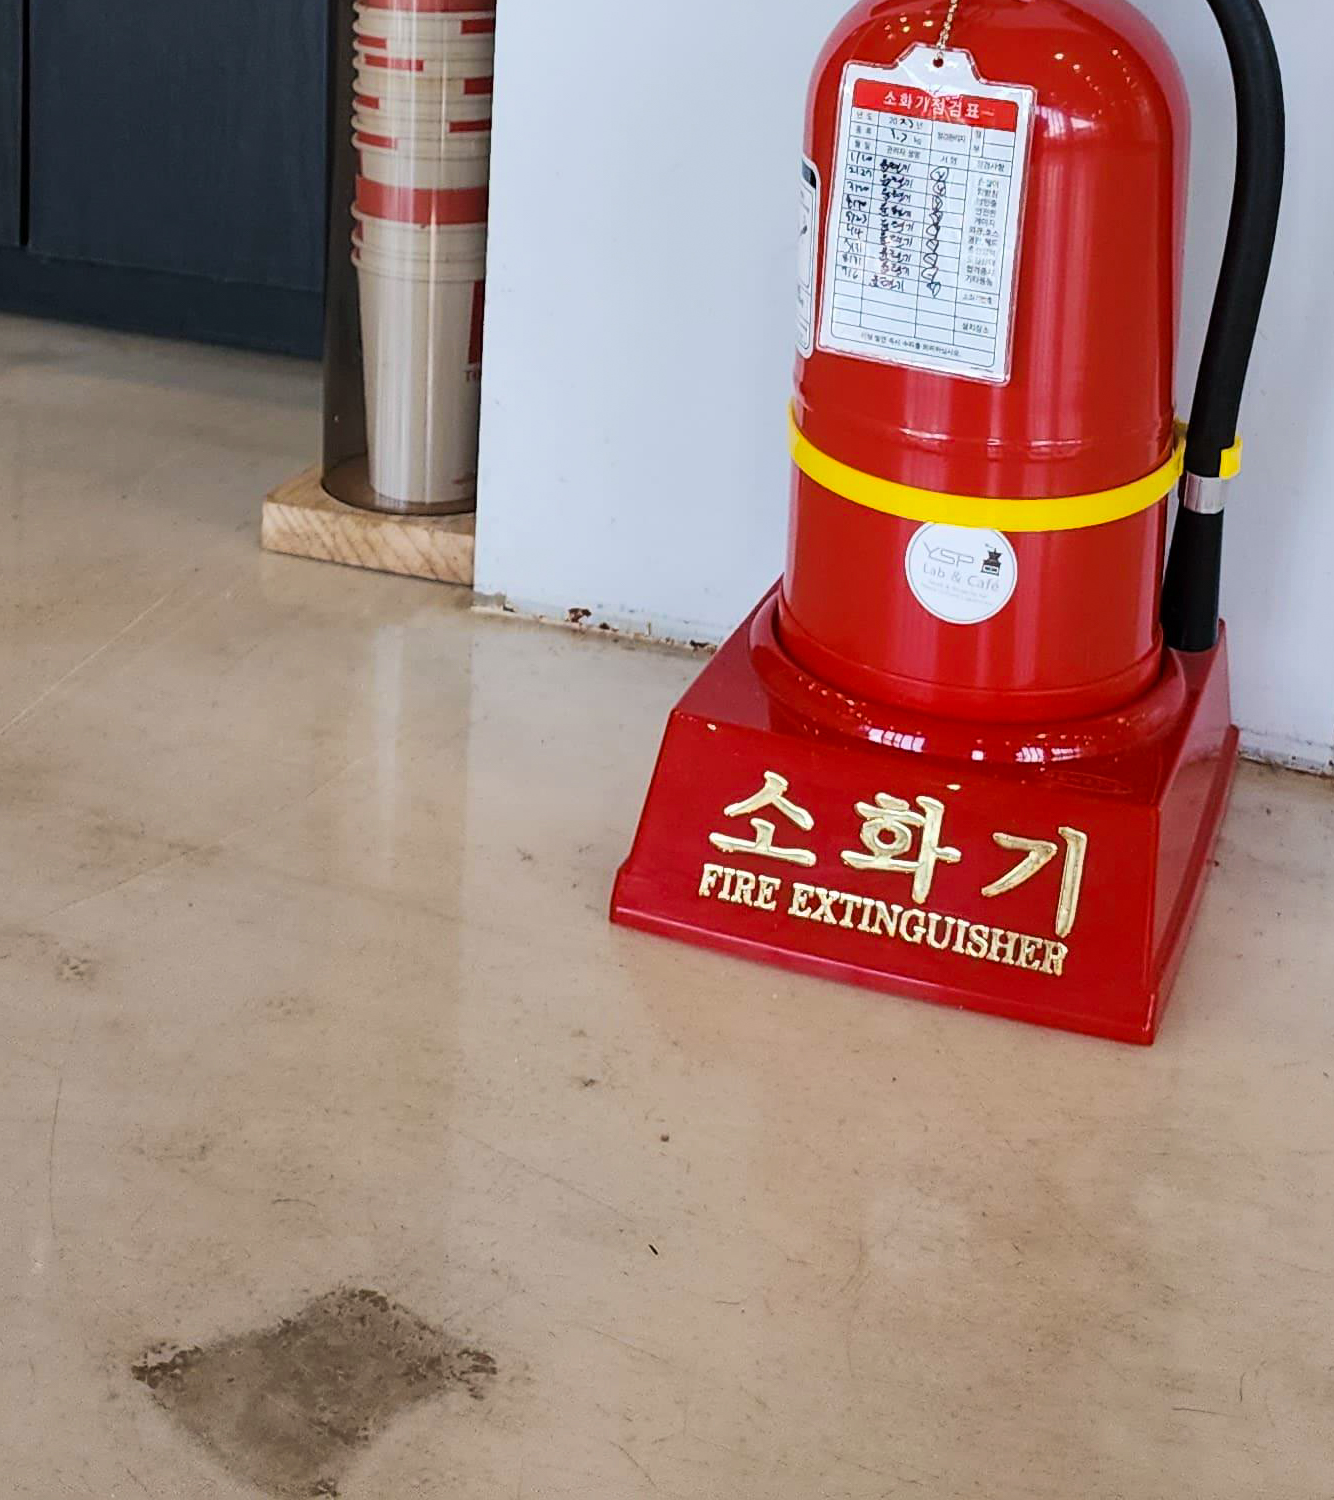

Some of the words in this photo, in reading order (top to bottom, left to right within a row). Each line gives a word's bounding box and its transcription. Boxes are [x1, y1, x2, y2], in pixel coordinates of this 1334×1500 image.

[699, 863, 782, 911] FIRE
[787, 883, 1069, 977] EXTINGUISHER
[708, 771, 1088, 938] 소화기
